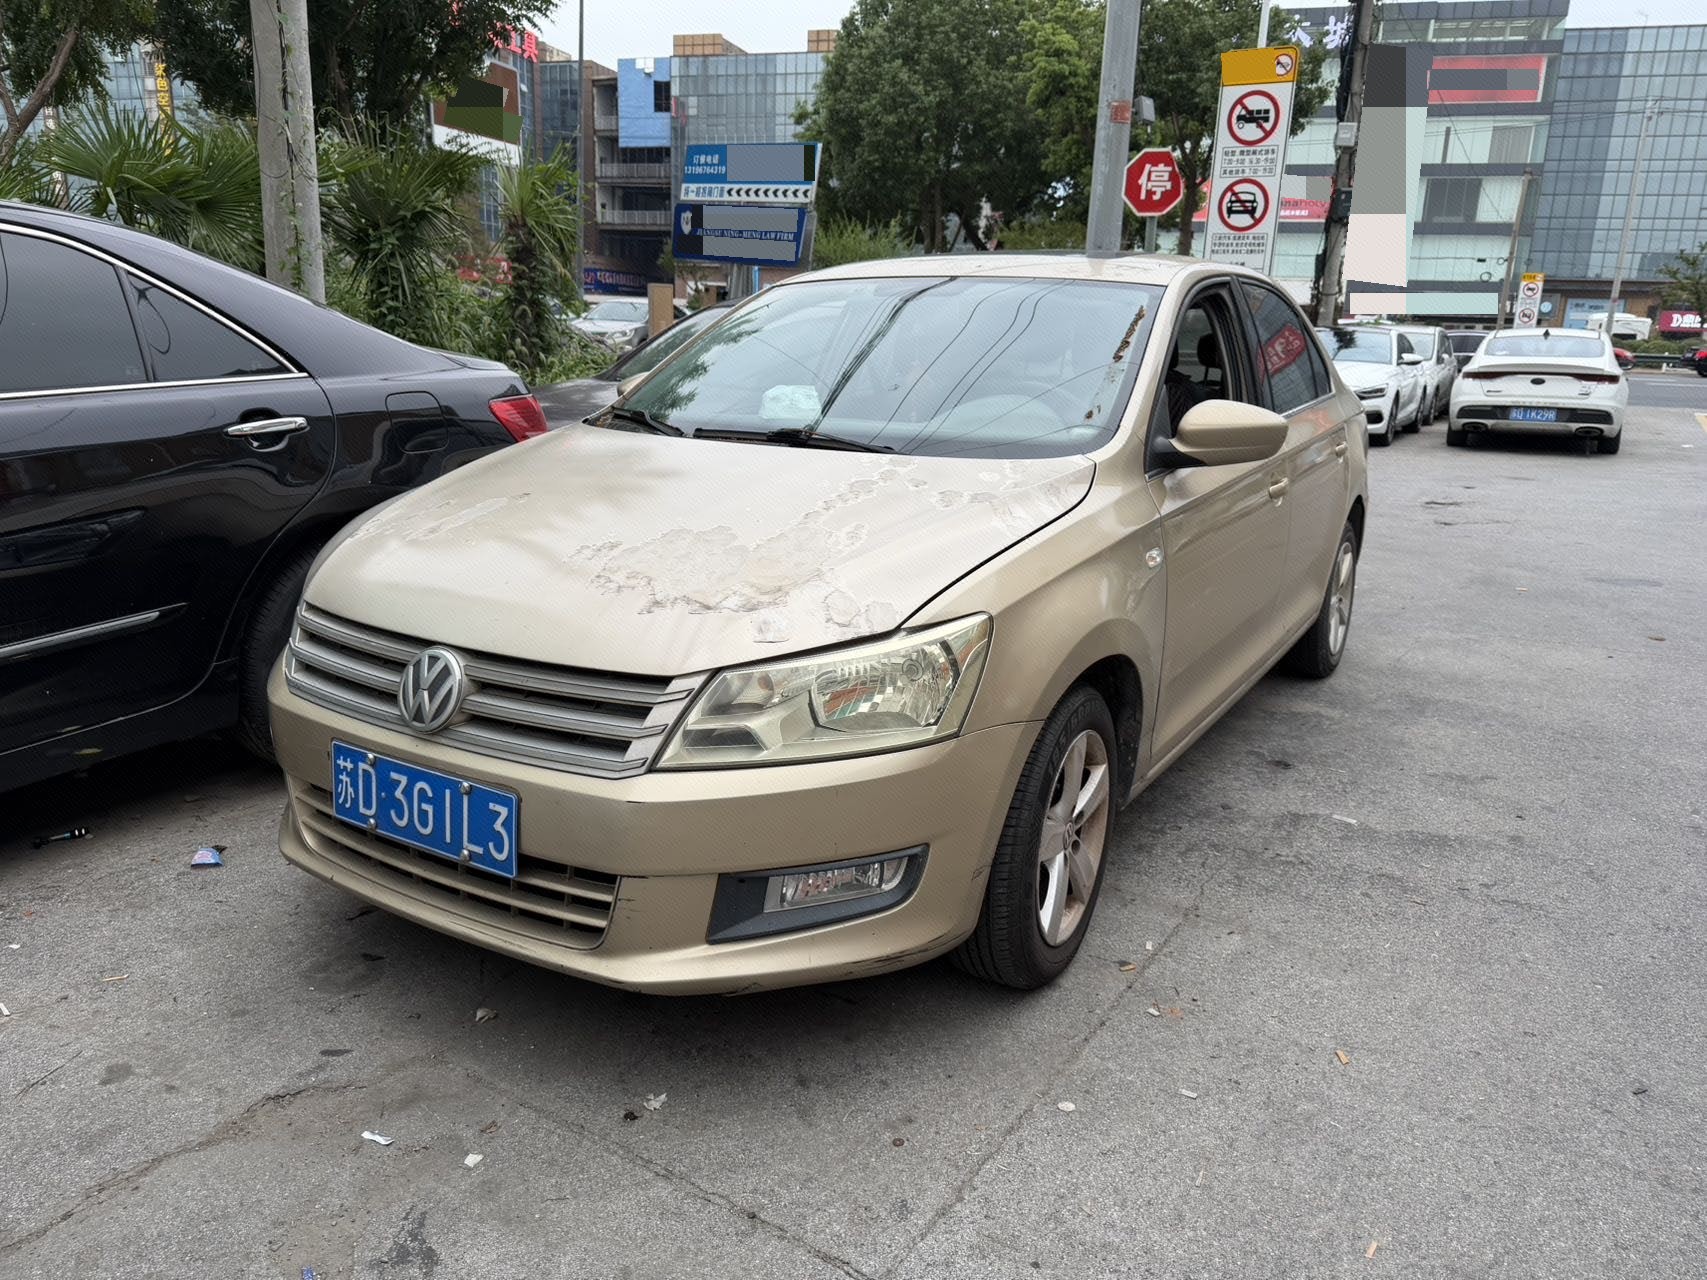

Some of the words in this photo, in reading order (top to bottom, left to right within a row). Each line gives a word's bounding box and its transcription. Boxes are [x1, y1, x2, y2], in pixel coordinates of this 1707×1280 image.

[1138, 163, 1172, 200] 停
[761, 231, 775, 240] LAW
[776, 232, 794, 241] FIRM
